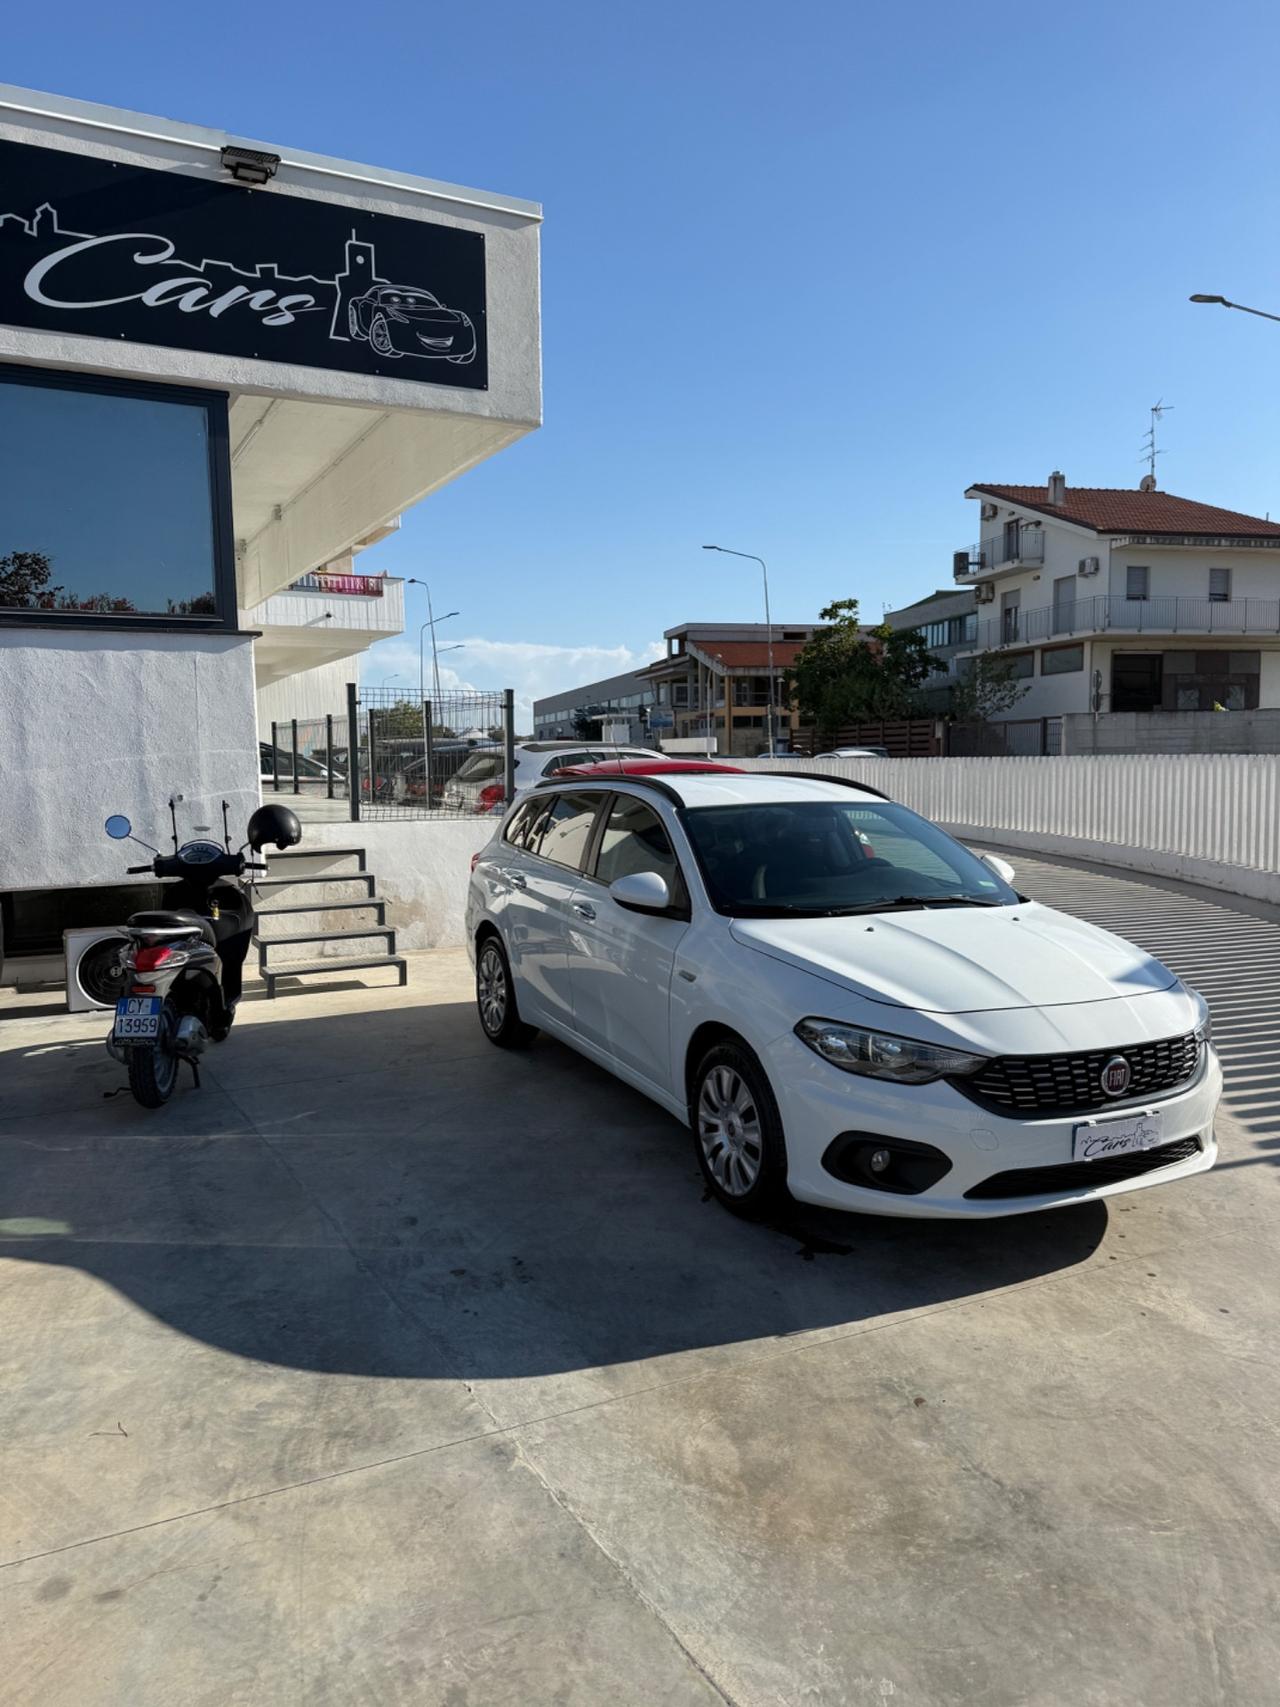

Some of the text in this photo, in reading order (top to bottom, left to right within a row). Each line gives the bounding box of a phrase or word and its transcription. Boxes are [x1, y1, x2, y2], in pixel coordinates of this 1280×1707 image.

[24, 233, 327, 326] Cars
[128, 999, 144, 1014] CY
[119, 1018, 157, 1033] 13959
[1109, 1069, 1126, 1087] FIAT
[1084, 1136, 1132, 1157] Cars
